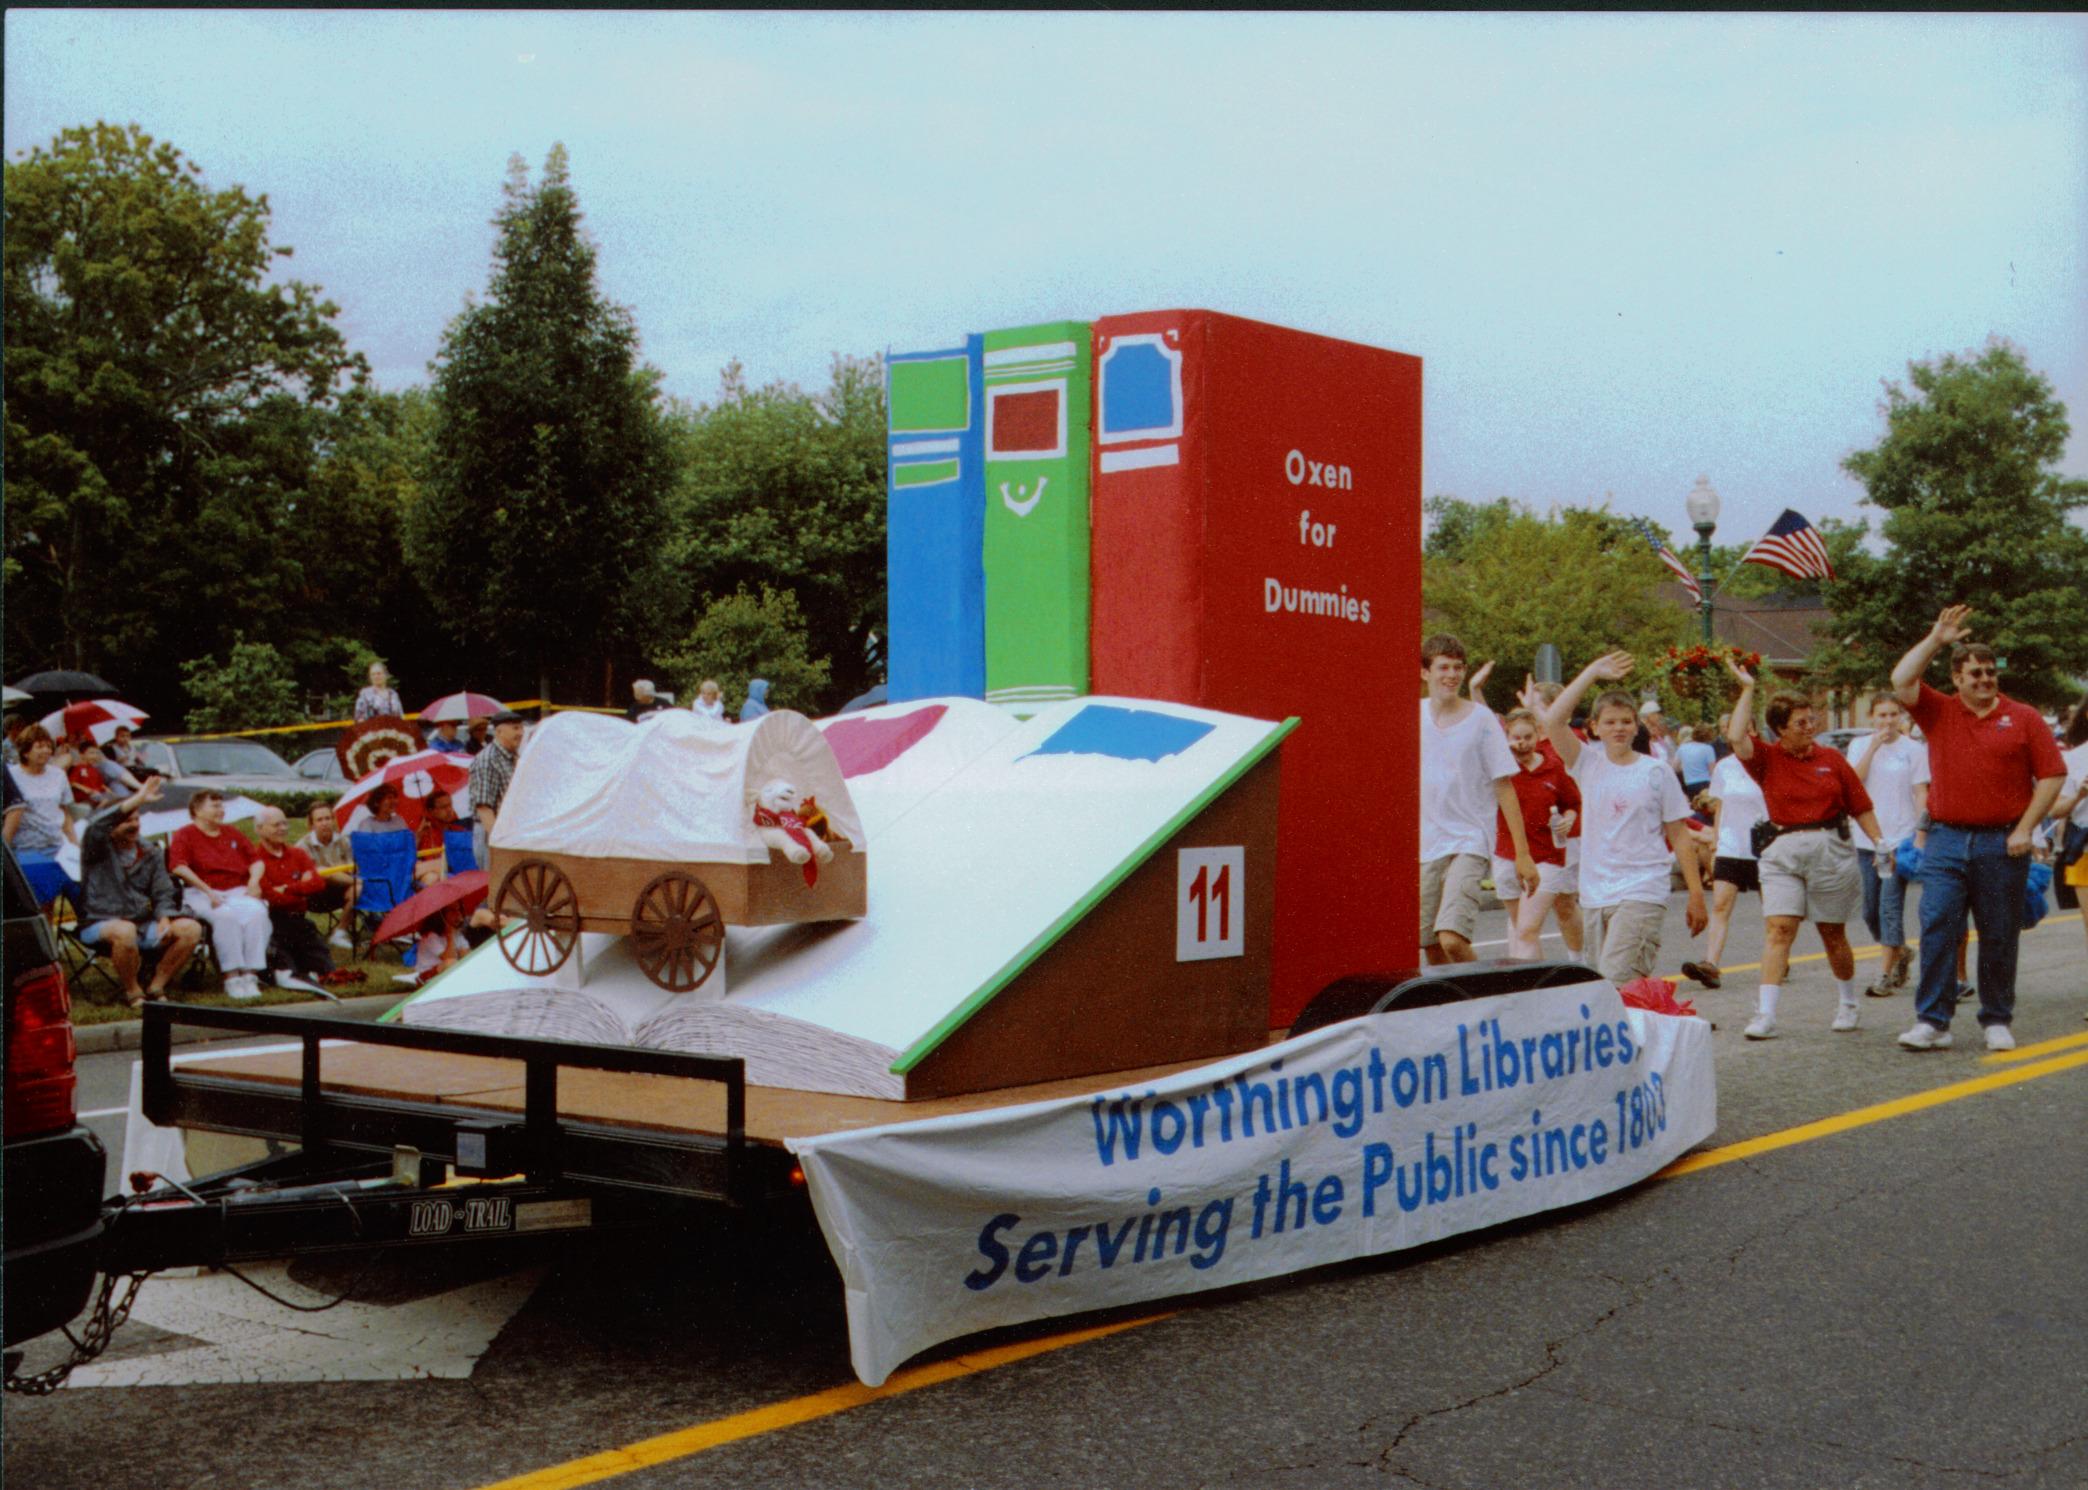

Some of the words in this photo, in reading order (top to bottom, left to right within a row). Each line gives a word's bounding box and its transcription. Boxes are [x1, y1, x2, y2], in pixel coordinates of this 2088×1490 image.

[1285, 449, 1353, 490] Oxen
[1300, 510, 1336, 548] for
[1264, 577, 1371, 623] Dummies
[1189, 864, 1230, 943] 11
[1092, 1046, 1448, 1166] Worthington
[410, 1200, 453, 1236] LOAD
[465, 1197, 512, 1232] TRAIL
[964, 1187, 1234, 1291] Serving
[1250, 1158, 1344, 1240] the
[1362, 1121, 1500, 1218] Public
[1509, 1109, 1608, 1182] since
